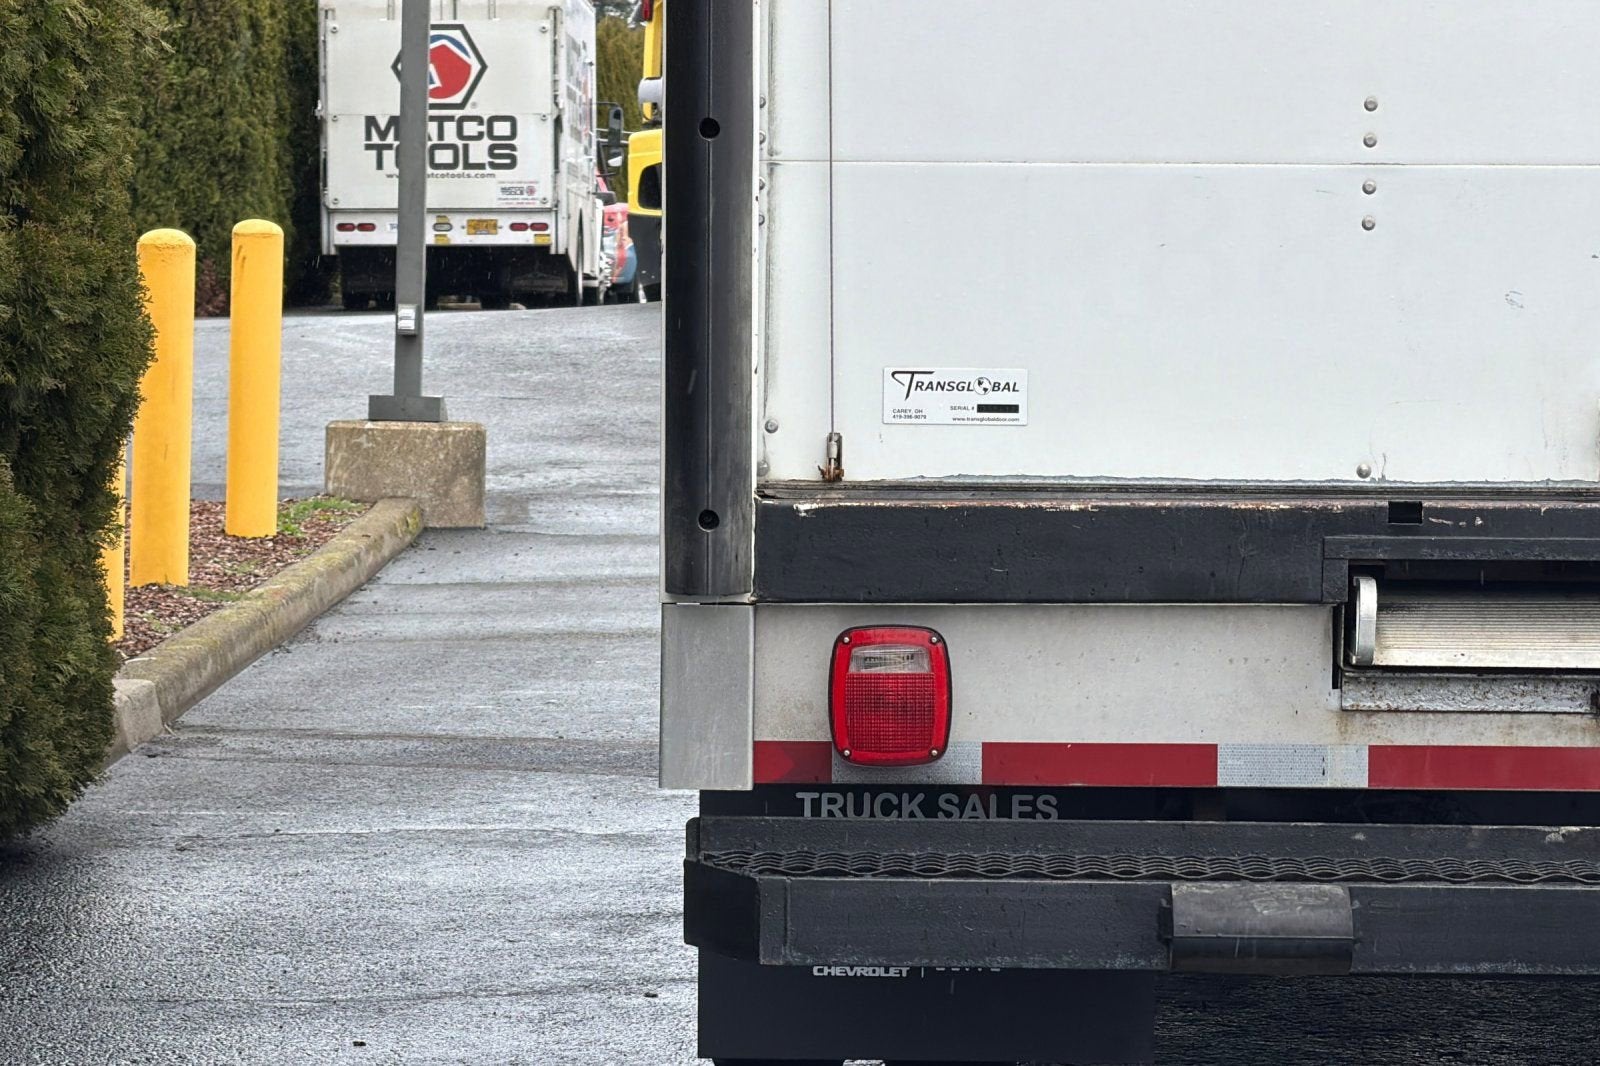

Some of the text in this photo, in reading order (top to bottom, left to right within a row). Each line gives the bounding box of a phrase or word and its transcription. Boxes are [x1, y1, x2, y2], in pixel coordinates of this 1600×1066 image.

[364, 115, 518, 142] MTCO
[364, 143, 518, 171] TOLS
[891, 370, 1020, 401] TRANSGLOBAL
[796, 792, 1059, 820] TRUCK SALES
[812, 965, 910, 977] CHEVROLET
